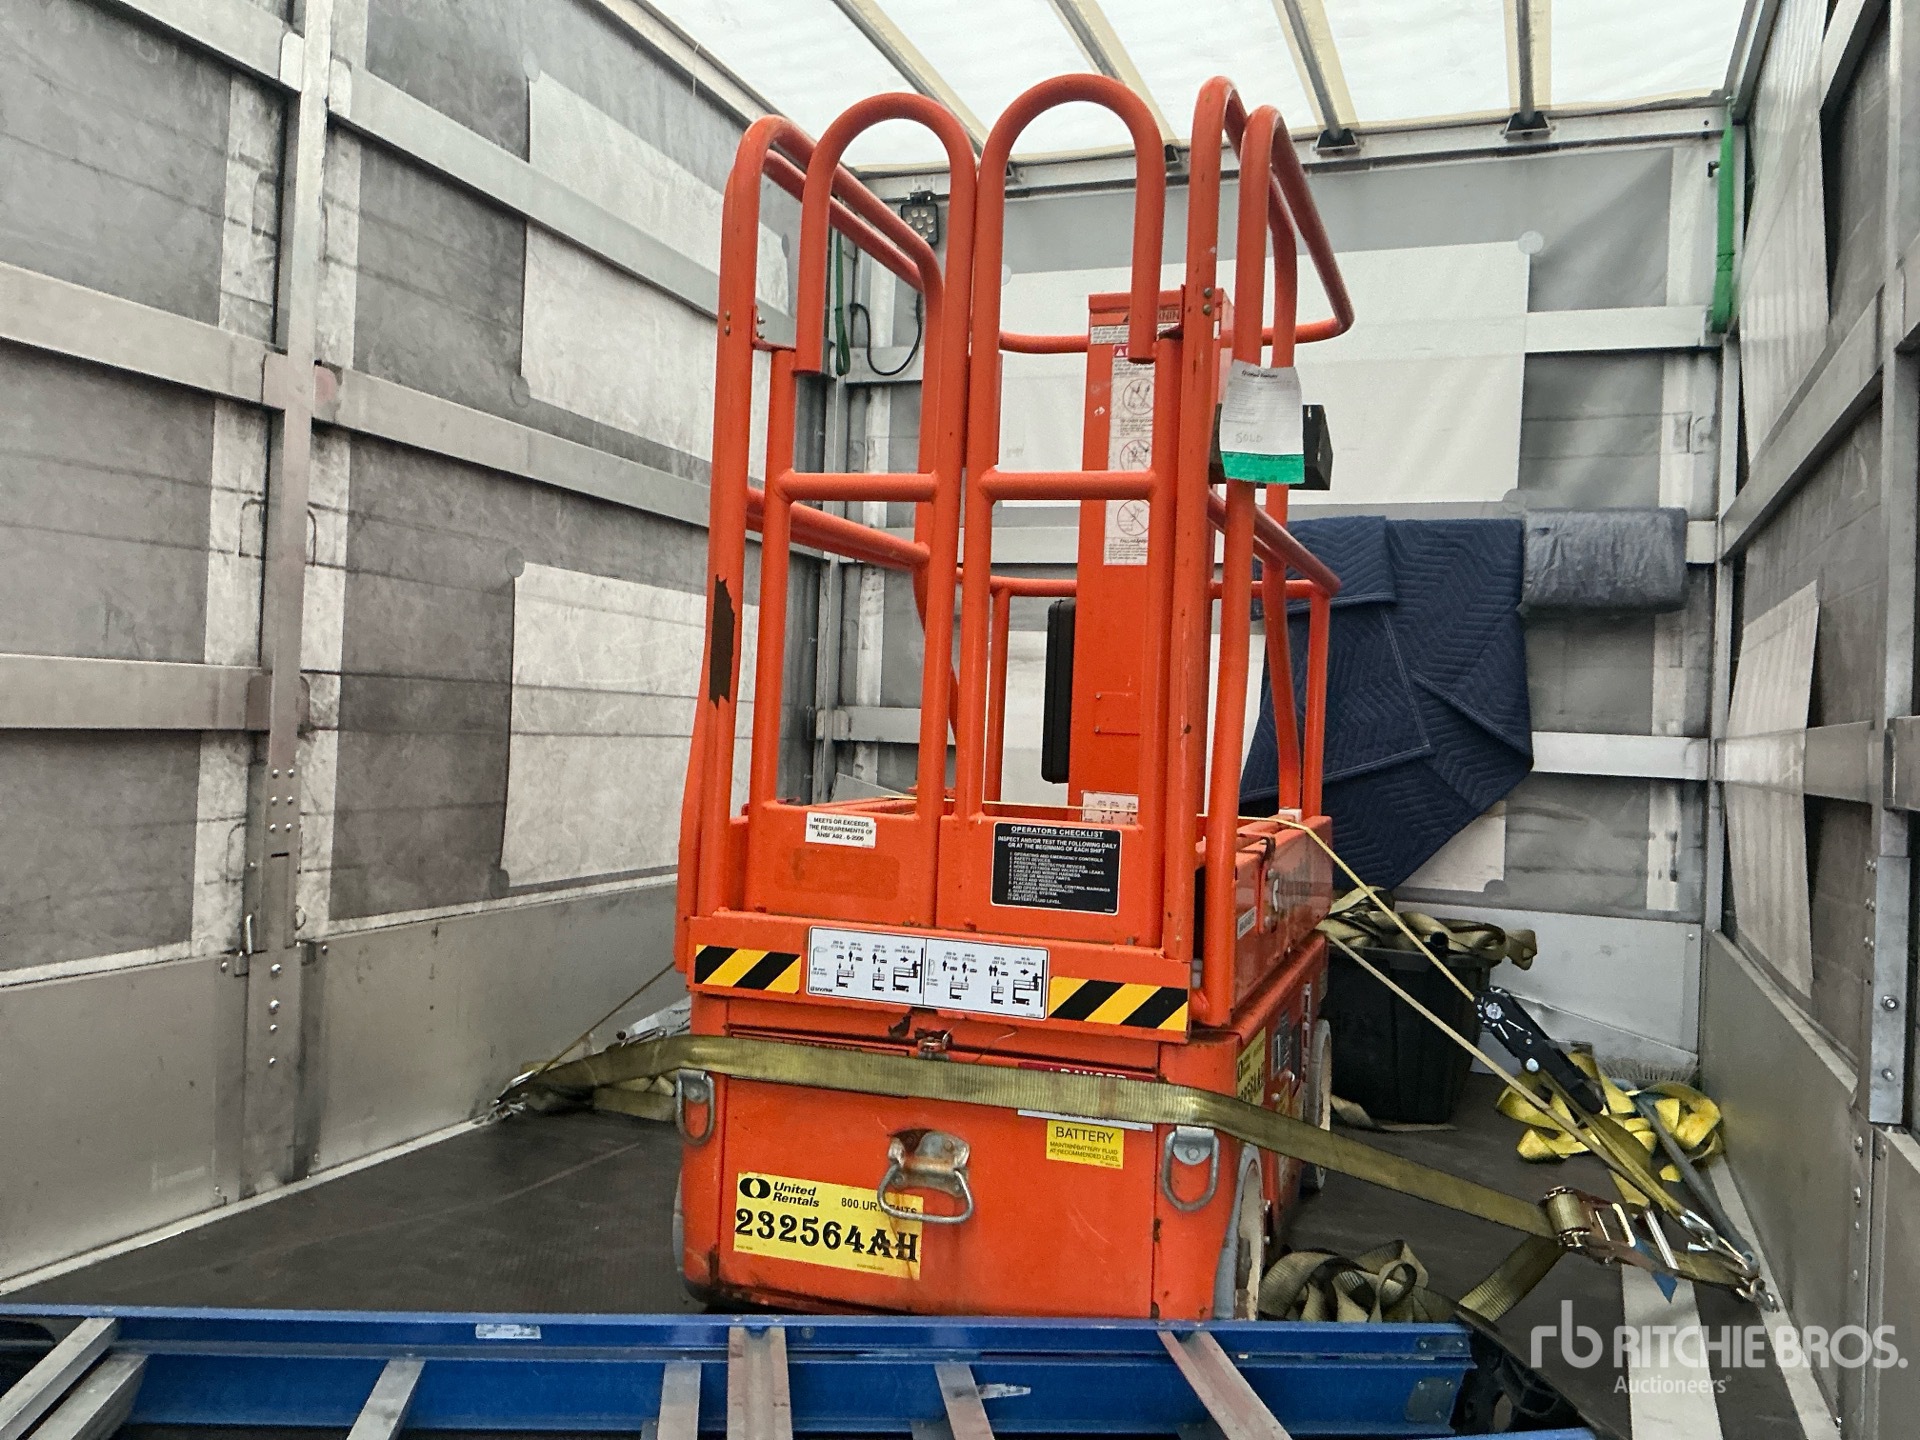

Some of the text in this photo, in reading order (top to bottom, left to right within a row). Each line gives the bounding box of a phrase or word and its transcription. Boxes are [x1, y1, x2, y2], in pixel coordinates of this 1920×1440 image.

[821, 825, 864, 833] REQUIREMENTS
[1011, 825, 1103, 838] OPERATORS CHECKLIST
[1068, 840, 1100, 848] FOLLOWING
[1056, 1126, 1114, 1144] BATTERY
[1057, 1149, 1101, 1159] RECOMMENDED
[774, 1182, 816, 1197] United
[773, 1192, 820, 1208] Rentals
[735, 1208, 918, 1262] 232564AH
